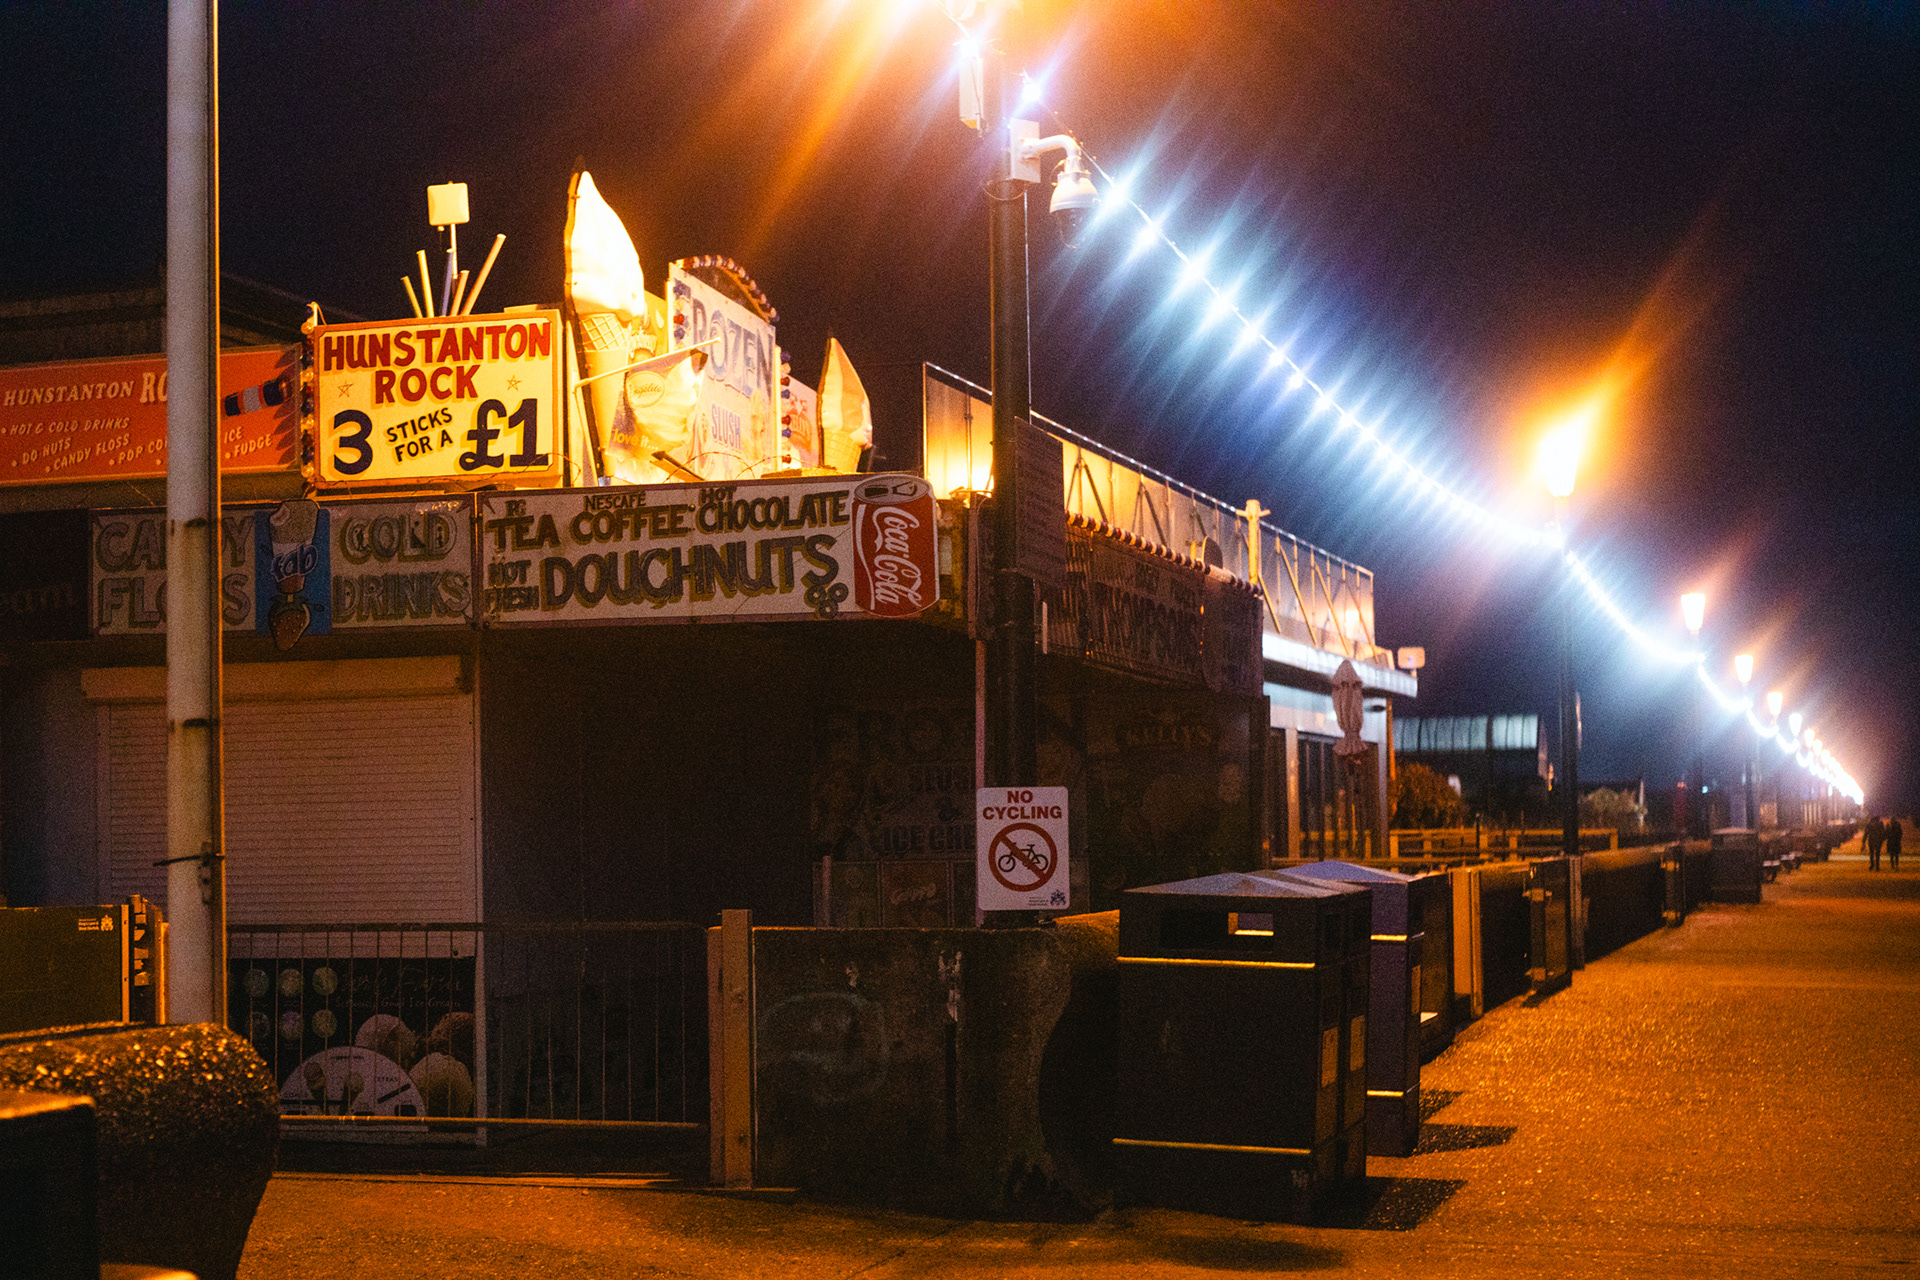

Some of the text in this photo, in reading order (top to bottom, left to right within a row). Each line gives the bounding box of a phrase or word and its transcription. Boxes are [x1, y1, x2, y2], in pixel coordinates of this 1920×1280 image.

[323, 323, 550, 372] HUNSTANTON
[3, 371, 168, 407] HUNSTANTON RO
[375, 364, 481, 405] ROCK
[10, 423, 32, 436] HOT
[49, 420, 80, 434] COLD
[83, 417, 130, 432] DRINKS
[224, 426, 242, 444] ICE
[333, 409, 373, 475] 3
[386, 407, 453, 443] STICKS
[459, 398, 549, 472] £1
[22, 437, 72, 465] DO NUTS
[53, 433, 130, 471] CANDY FLOSS
[118, 438, 168, 464] POP CO
[234, 433, 272, 457] FUDGE
[395, 429, 453, 462] FOR A
[505, 500, 527, 516] PG
[700, 485, 737, 503] HOT
[340, 513, 458, 565] COLD
[485, 490, 849, 553] TEA COFFEE CHOCOLATE
[97, 516, 255, 572] CAY
[488, 559, 531, 587] HOT
[98, 573, 251, 630] FLS
[333, 570, 472, 624] DRINKS
[982, 805, 1063, 820] CYCLING
[1006, 790, 1034, 803] NO
